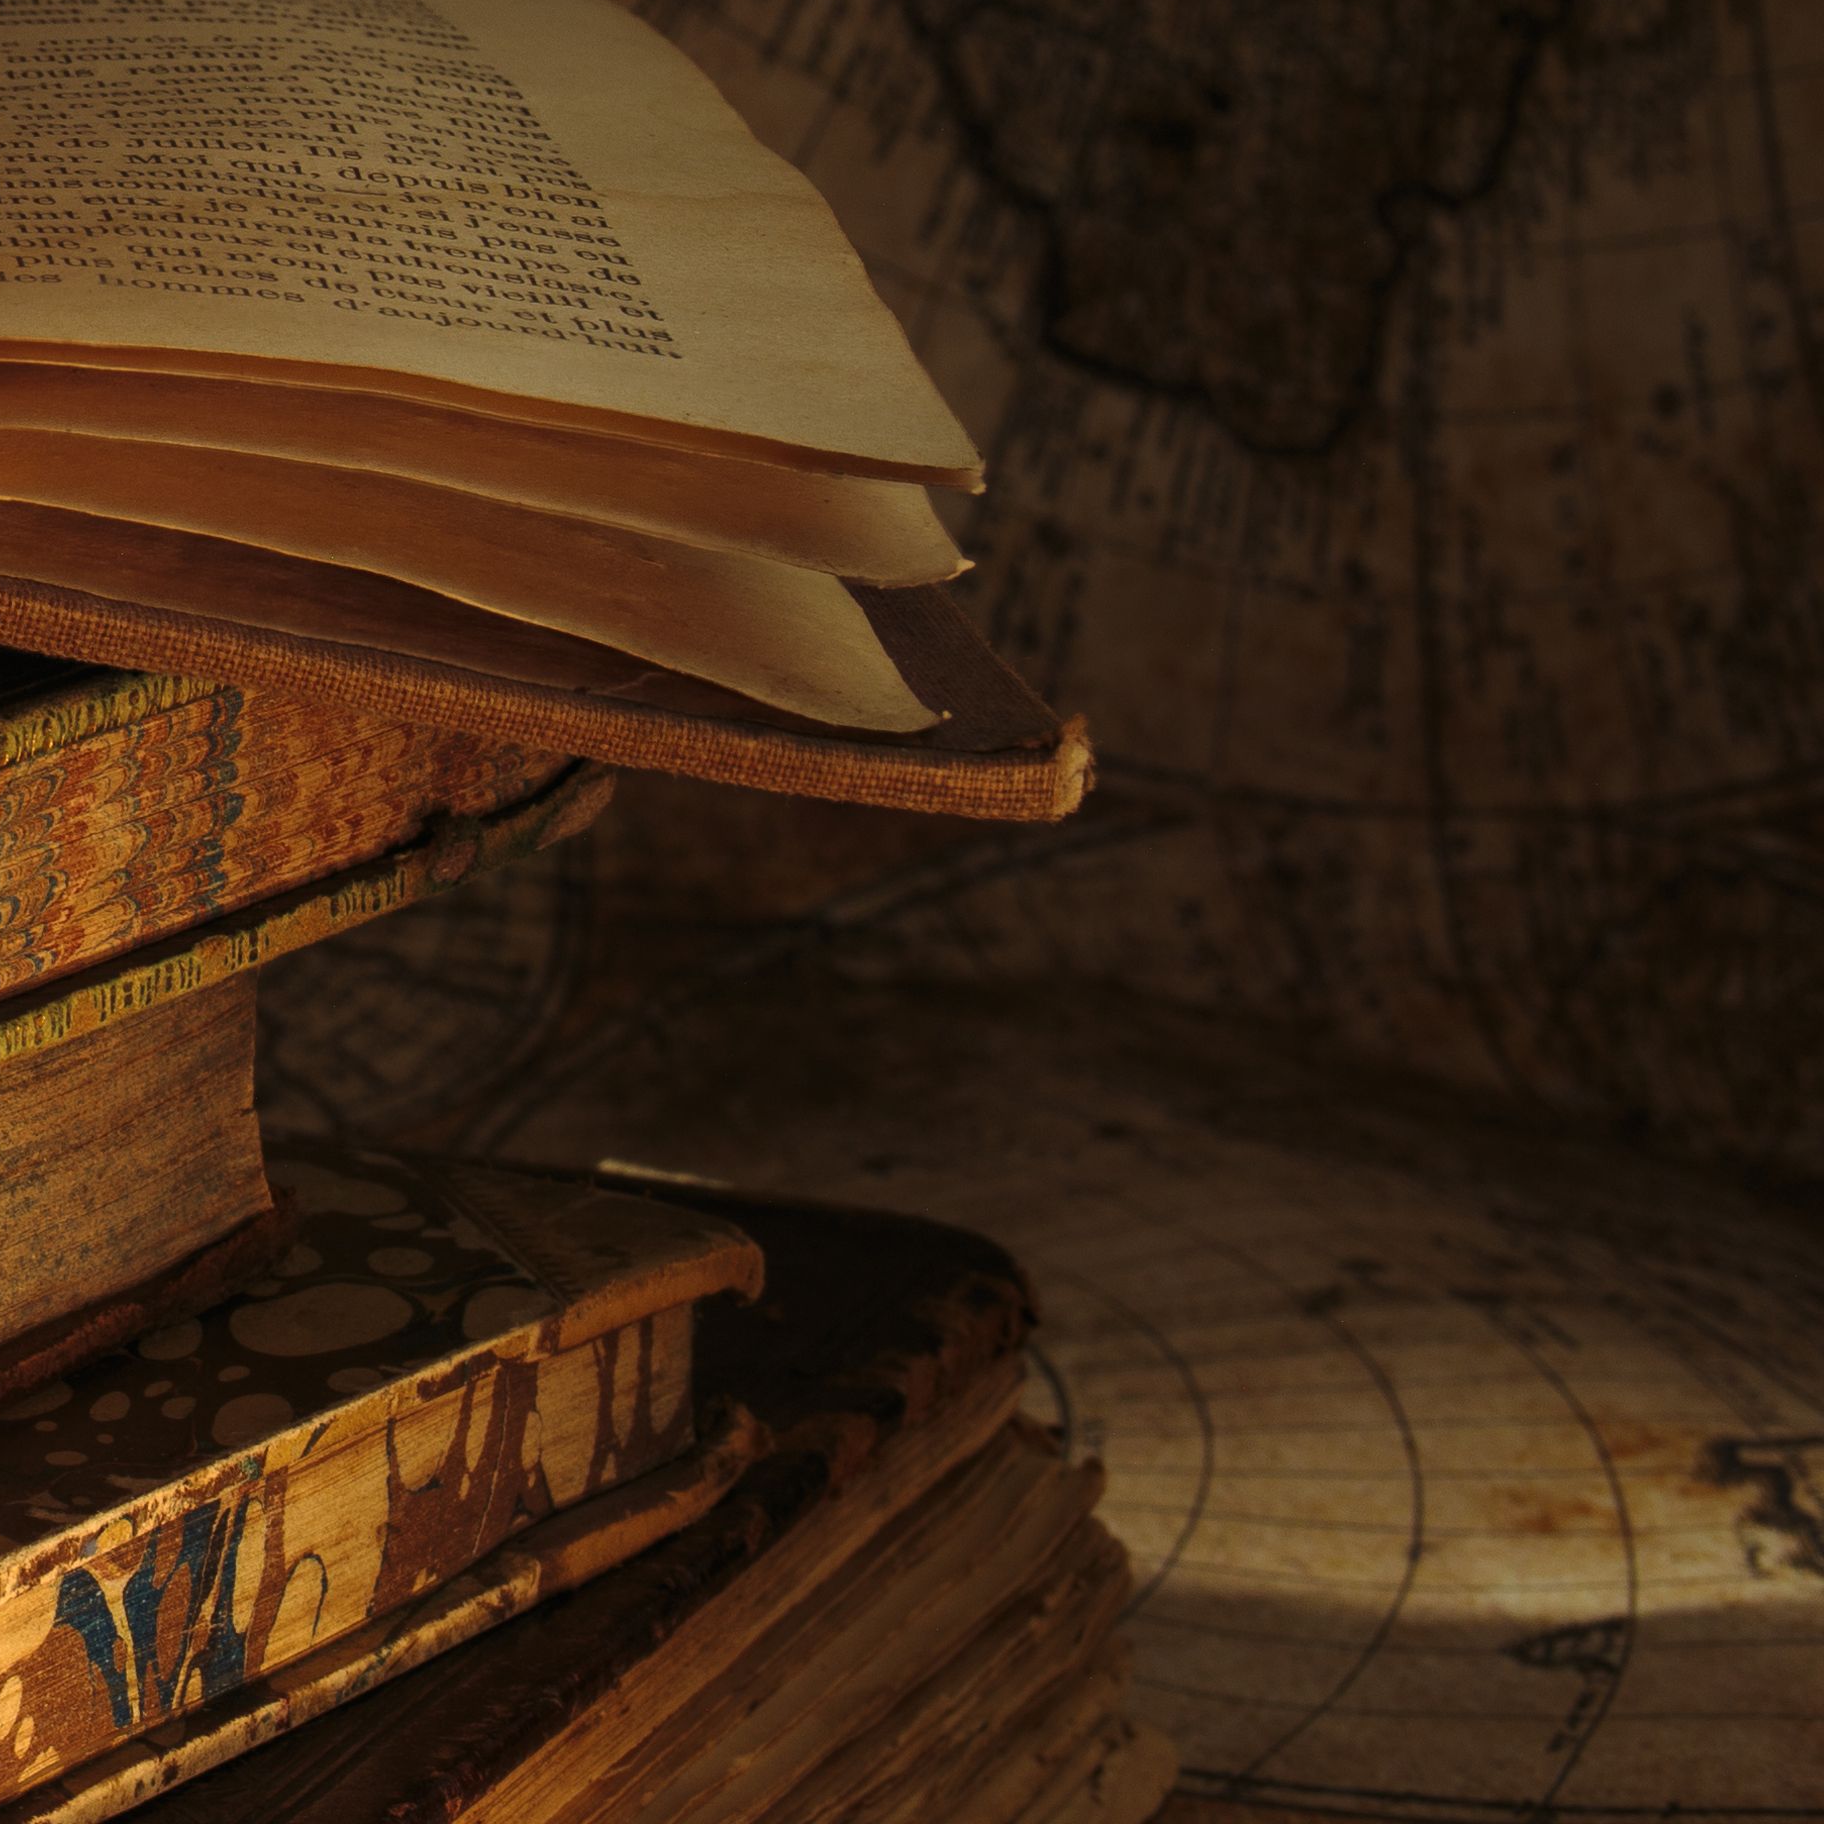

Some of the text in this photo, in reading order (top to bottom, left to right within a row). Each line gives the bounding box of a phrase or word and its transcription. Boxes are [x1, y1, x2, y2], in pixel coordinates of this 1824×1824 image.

[3, 68, 94, 80] tous
[126, 63, 263, 75] réunis
[288, 63, 384, 79] avec
[413, 74, 524, 100] leurs
[55, 137, 110, 148] de
[125, 137, 286, 154] Juillet.
[302, 144, 363, 160] Ils
[383, 153, 503, 176] n'ont
[515, 172, 592, 191] pas
[121, 153, 213, 166] Moi
[227, 159, 321, 179] qui,
[336, 165, 490, 194] depuis
[500, 183, 603, 209] bien
[42, 166, 97, 175] de
[113, 168, 326, 192] politique
[398, 191, 442, 204] je
[456, 199, 560, 222] n'en
[570, 215, 613, 229] ai
[351, 200, 408, 218] et,
[415, 209, 454, 222] si
[463, 213, 621, 247] j'eusse
[15, 223, 275, 247] impétueux
[285, 240, 330, 255] et
[79, 194, 185, 209] eux,
[202, 197, 248, 212] je
[264, 205, 458, 240] n'aurais
[476, 235, 558, 254] pas
[572, 249, 634, 267] eu
[346, 230, 392, 246] la
[401, 239, 571, 274] trempe
[586, 266, 641, 286] de
[11, 253, 115, 268] plus
[130, 260, 279, 282] riches
[301, 276, 359, 294] de
[371, 286, 493, 313] cœur
[509, 310, 558, 324] et
[569, 316, 674, 342] plus
[97, 273, 305, 303] hommes
[124, 244, 203, 258] qui
[225, 251, 348, 274] n'ont
[364, 268, 446, 290] pas
[460, 283, 594, 310] vieilli
[617, 304, 664, 321] et
